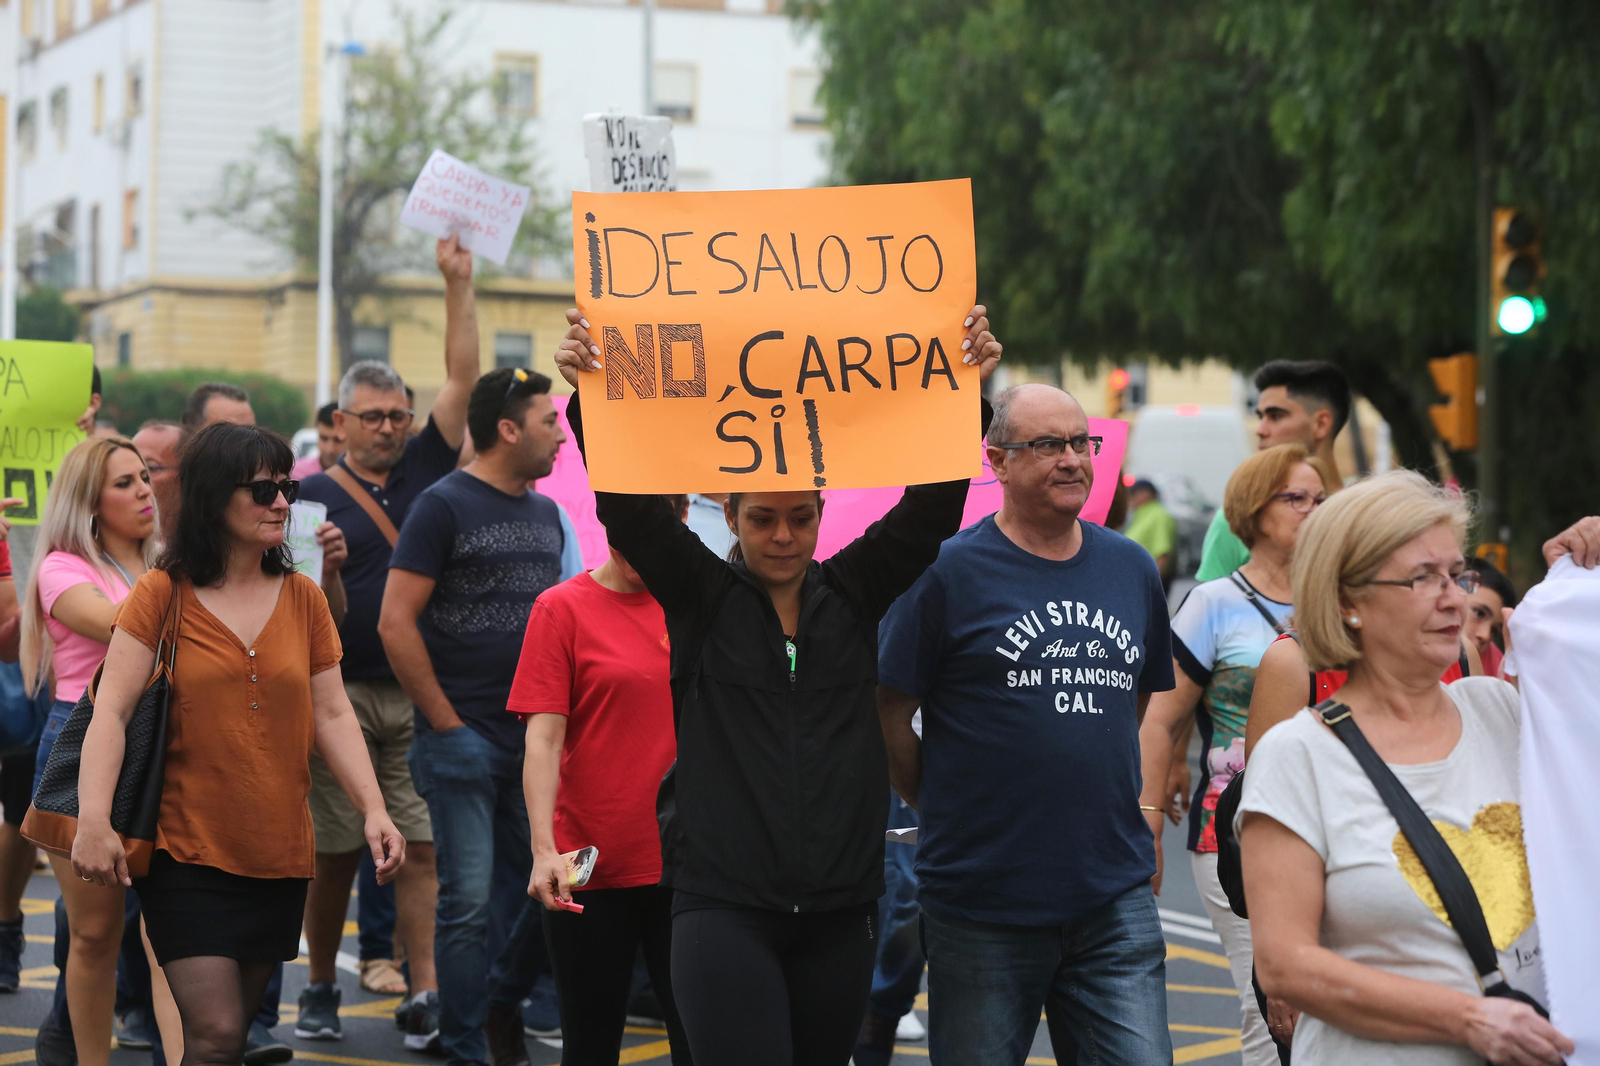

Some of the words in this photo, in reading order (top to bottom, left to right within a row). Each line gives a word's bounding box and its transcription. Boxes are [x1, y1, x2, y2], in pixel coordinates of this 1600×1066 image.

[418, 176, 511, 224] QUEREMOS
[431, 157, 490, 194] CARPA
[501, 186, 523, 207] YA
[739, 330, 959, 399] CARPA
[996, 610, 1045, 662] LEVI
[1046, 600, 1139, 664] STRAUSS
[1041, 639, 1080, 658] And
[1086, 640, 1109, 658] Co.
[1007, 669, 1042, 687] SAN
[1052, 668, 1133, 691] FRANCISCO
[1055, 691, 1103, 714] CAL.
